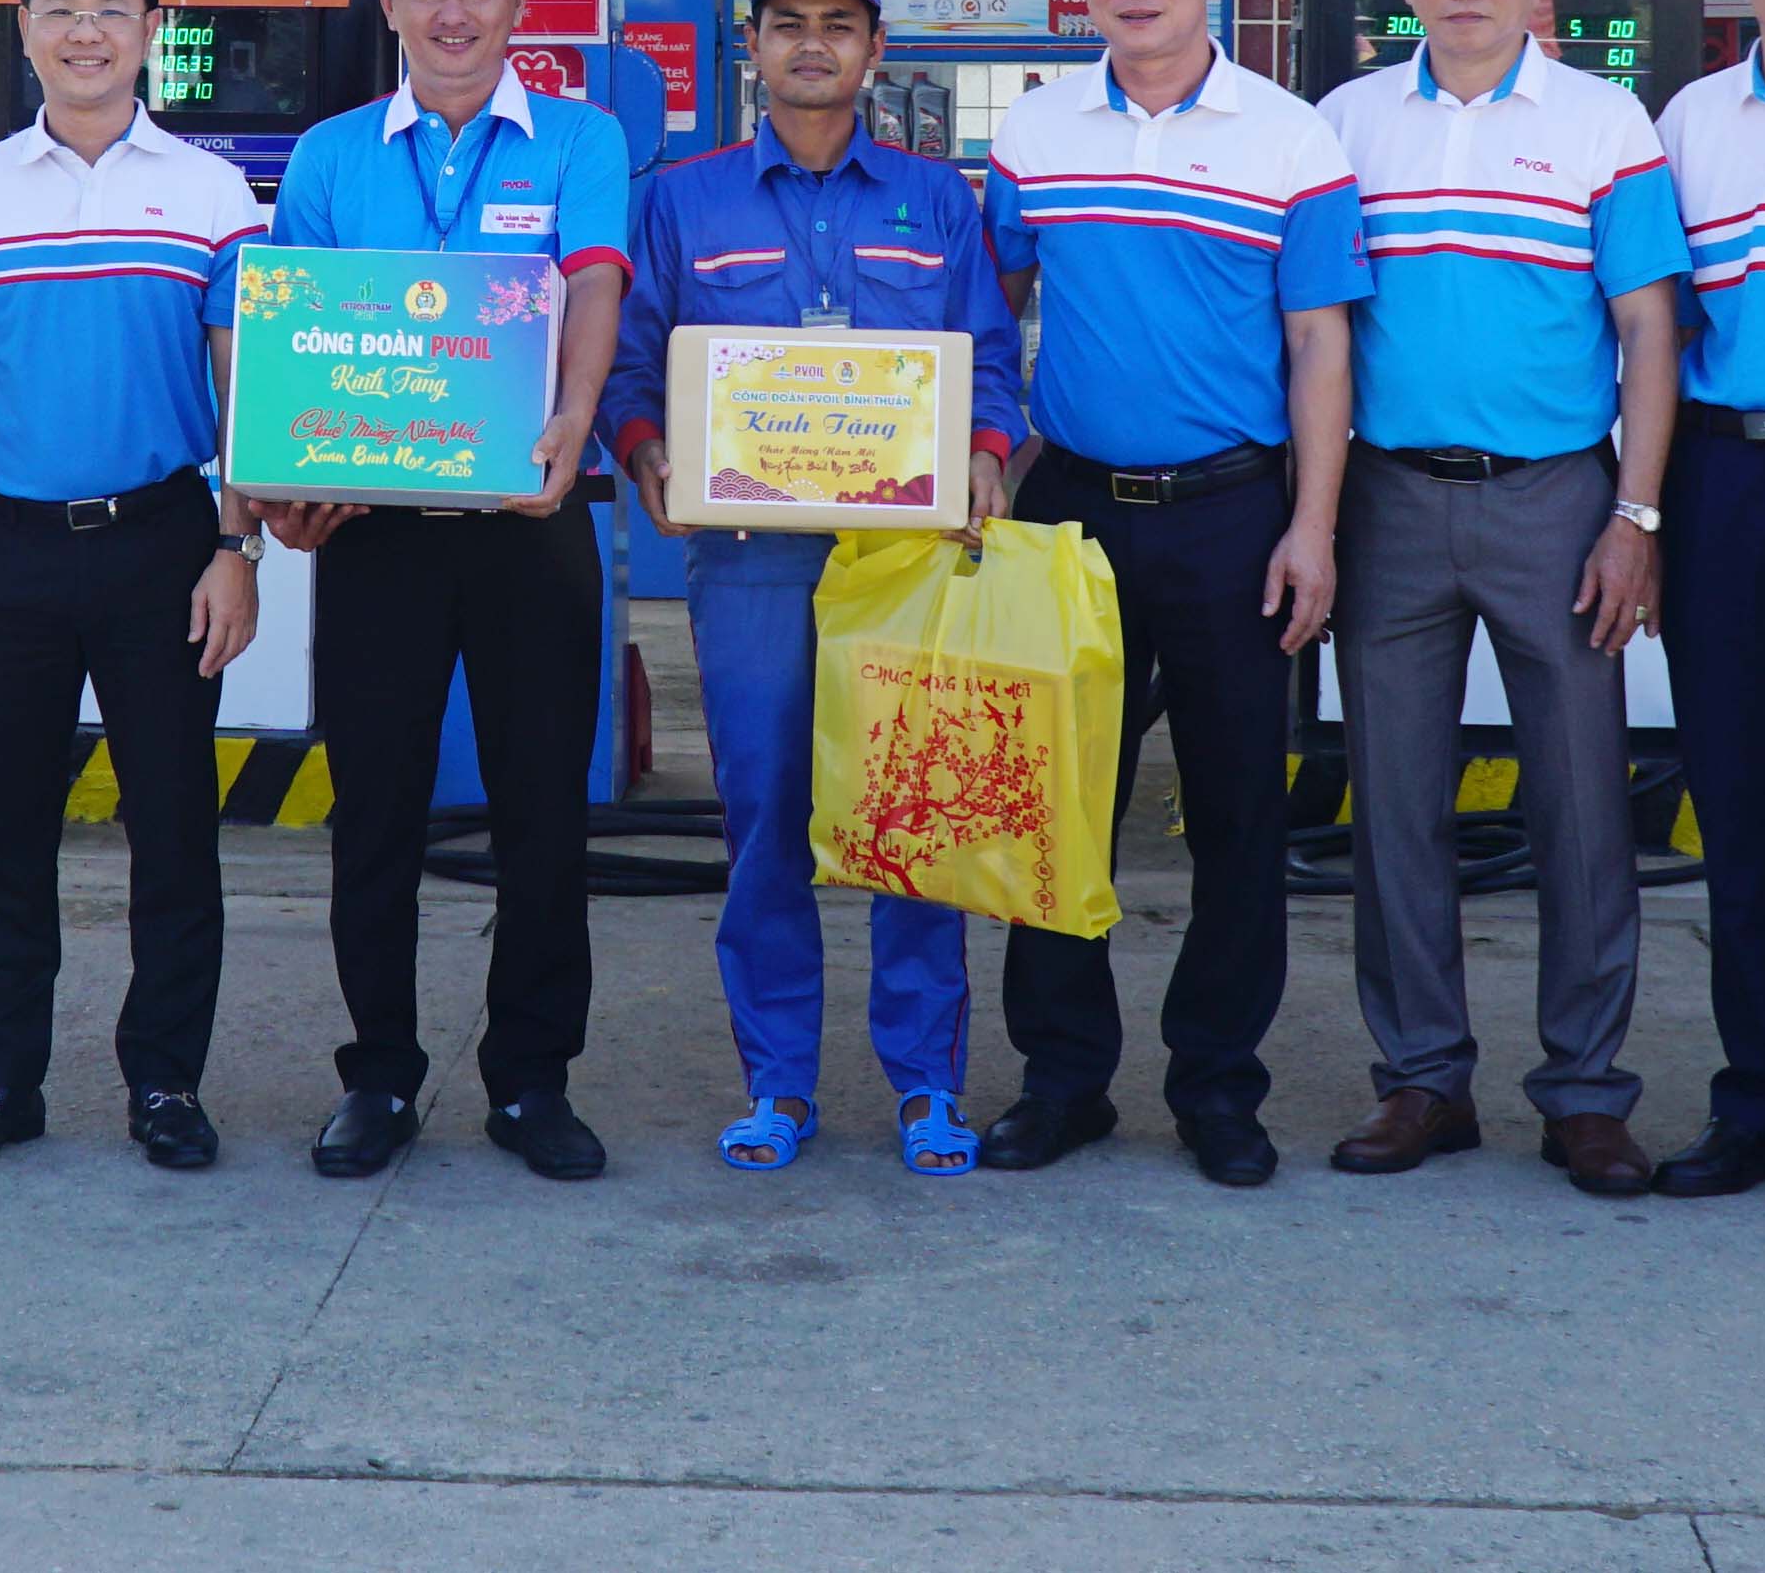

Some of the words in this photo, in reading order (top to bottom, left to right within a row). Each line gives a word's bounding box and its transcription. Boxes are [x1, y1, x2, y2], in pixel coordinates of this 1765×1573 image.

[1513, 157, 1555, 174] PVOIL
[502, 180, 532, 190] PVOIL
[340, 302, 392, 312] PETROVIETNAM
[292, 326, 354, 355] CÔNG
[360, 329, 423, 357] ĐOÀN
[430, 334, 492, 360] PVOIL
[794, 365, 826, 378] PVOIL
[732, 391, 768, 403] CÔNG
[771, 390, 804, 404] ĐOÀN
[808, 393, 841, 404] PVOIL
[844, 392, 873, 405] BÌNH
[874, 394, 912, 408] THUẬN
[736, 410, 811, 434] Kính
[823, 412, 898, 441] Tặng
[436, 461, 473, 478] 2026
[860, 663, 913, 686] CHÚC
